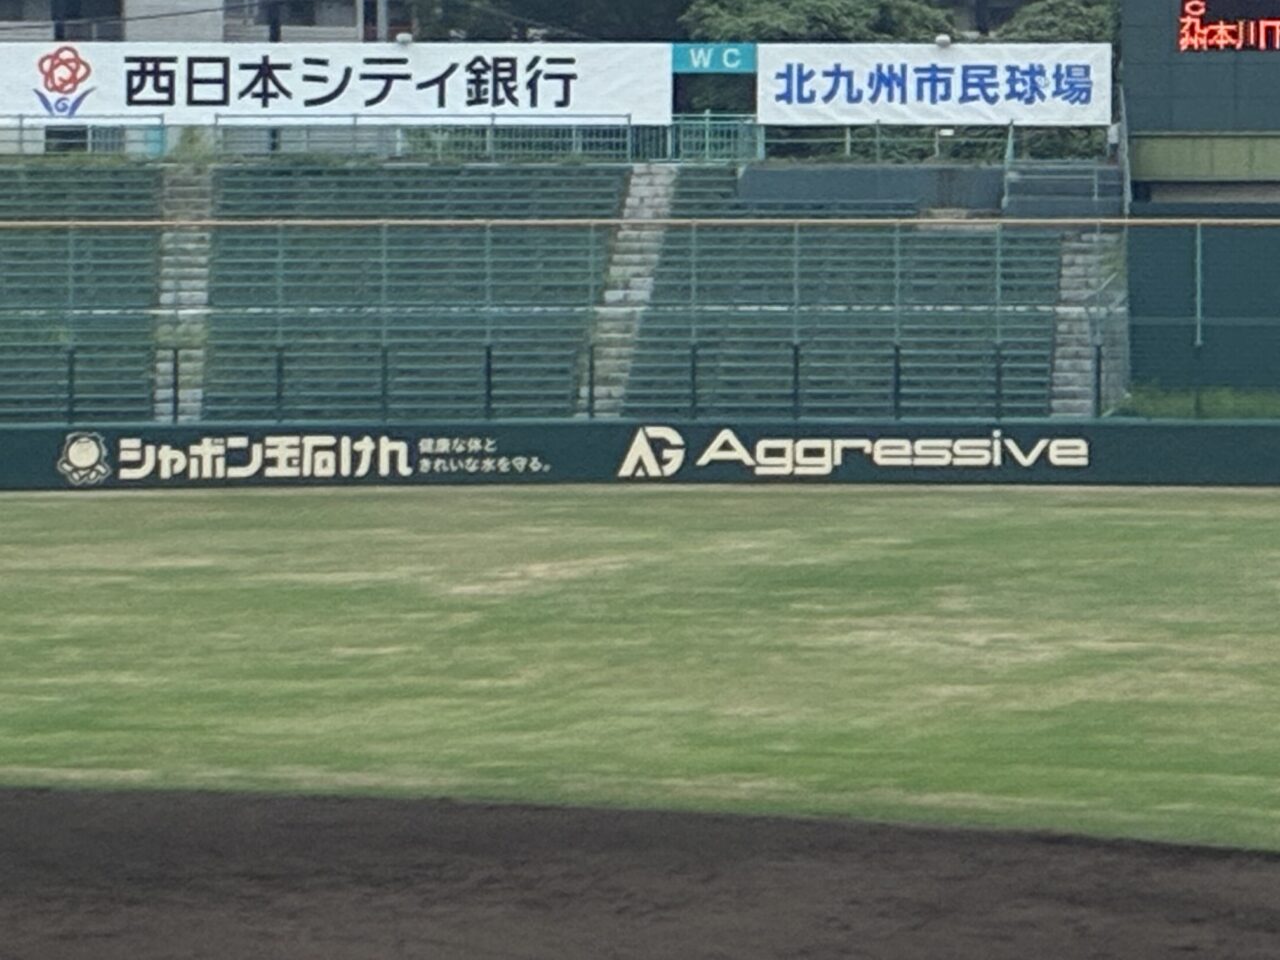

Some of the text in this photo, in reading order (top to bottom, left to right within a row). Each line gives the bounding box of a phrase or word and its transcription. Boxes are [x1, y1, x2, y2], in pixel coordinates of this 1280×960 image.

[690, 48, 742, 69] WC
[124, 54, 579, 109] 西日本シティ銀行
[774, 62, 1094, 106] 北九州市民球場
[118, 436, 413, 480] シャボン玉石けん
[696, 428, 1089, 476] Aggressive
